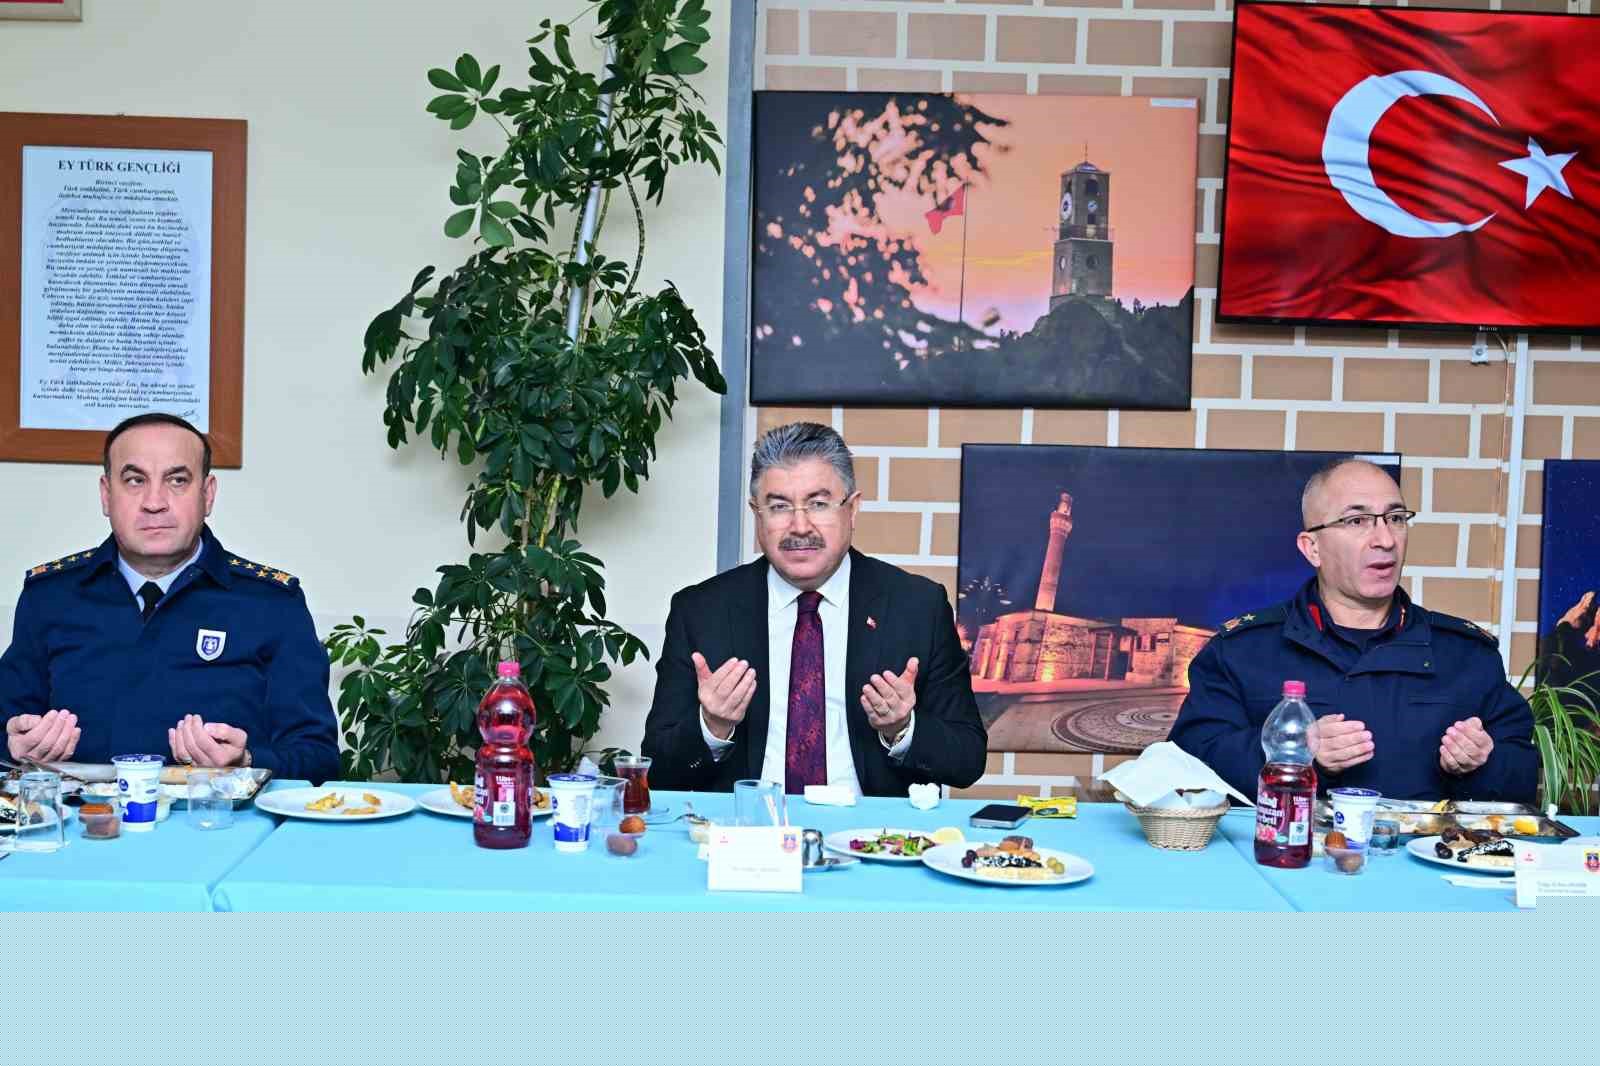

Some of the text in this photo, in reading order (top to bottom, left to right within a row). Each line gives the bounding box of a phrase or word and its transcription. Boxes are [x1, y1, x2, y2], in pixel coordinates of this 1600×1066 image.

[58, 158, 181, 175] EY TÜRK GENÇLİĞİ
